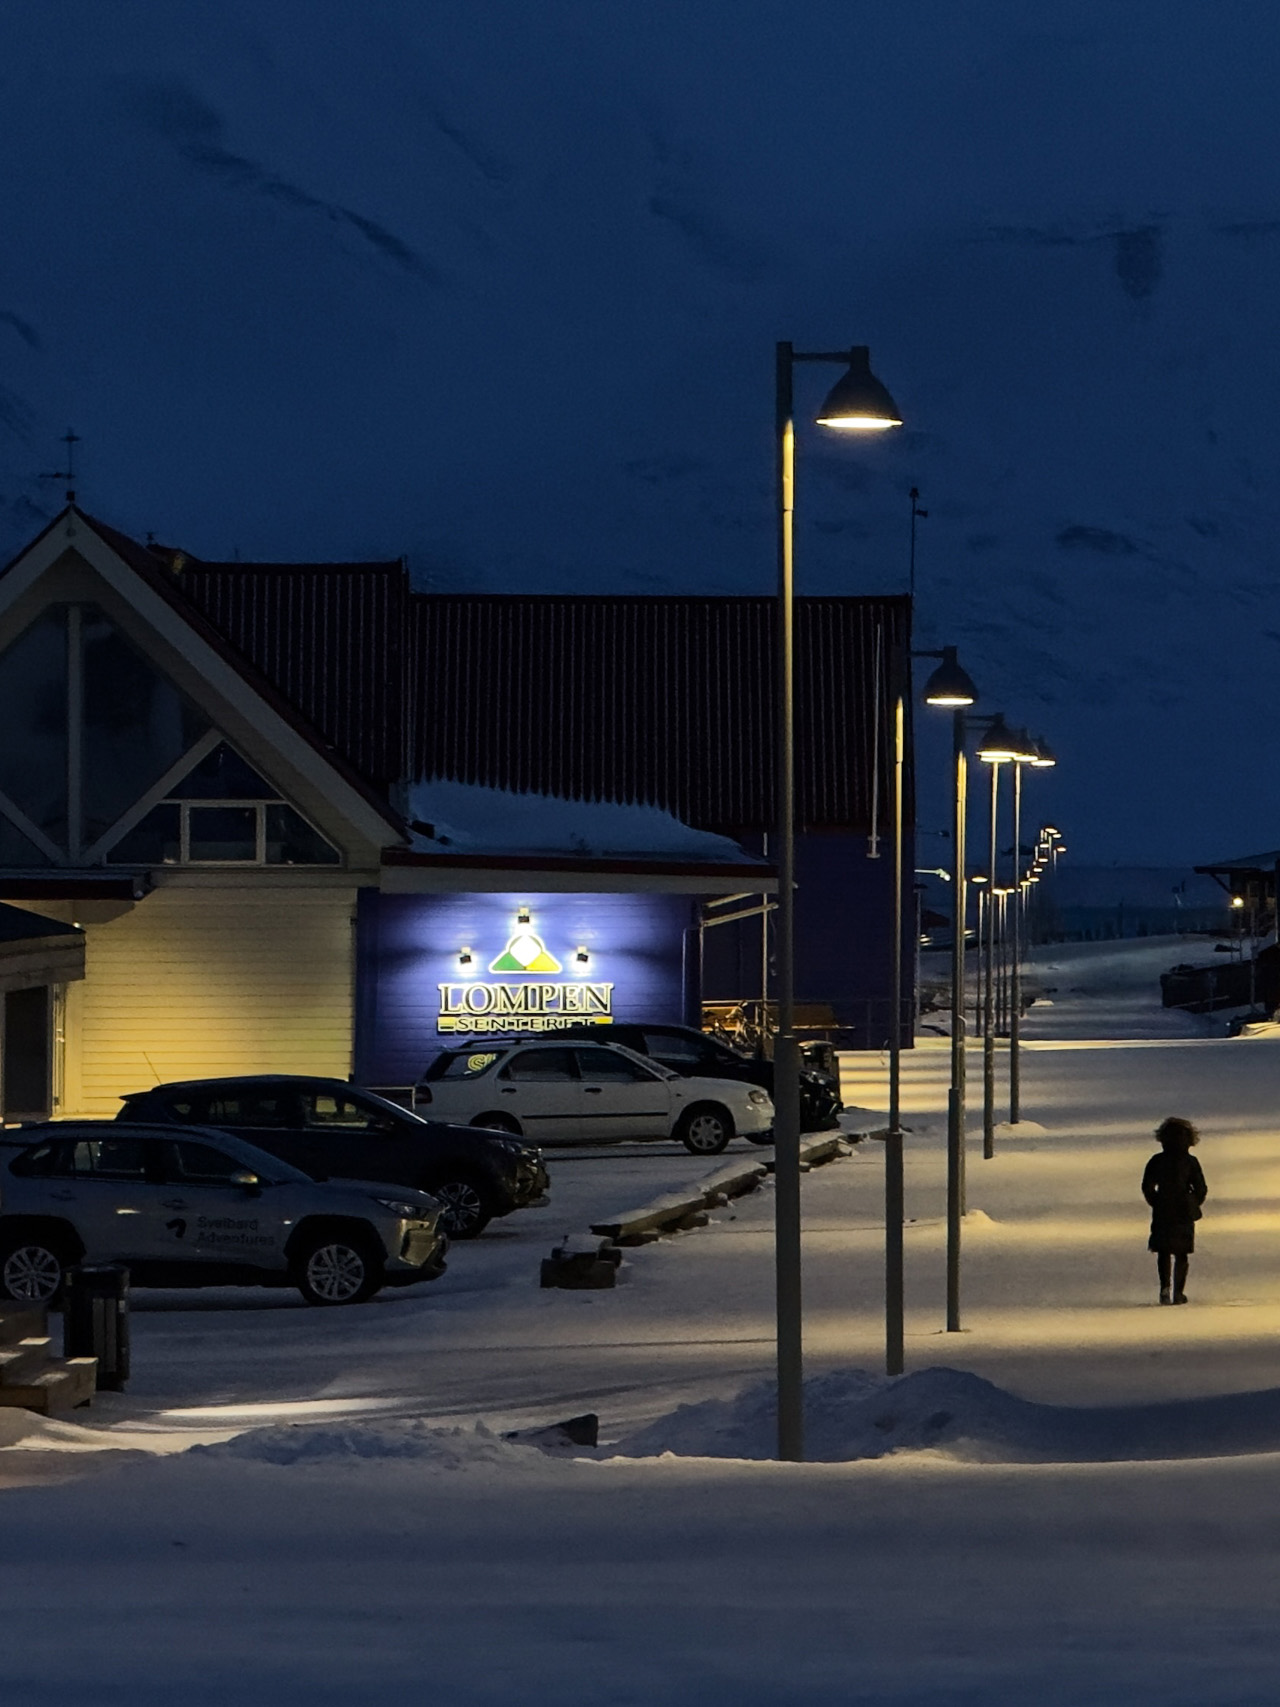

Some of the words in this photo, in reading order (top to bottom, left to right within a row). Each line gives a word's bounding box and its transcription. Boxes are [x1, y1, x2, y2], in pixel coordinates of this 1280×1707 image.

[438, 982, 613, 1014] LOMPEN
[198, 1216, 258, 1230] Svalbard
[198, 1232, 275, 1246] Adventures
